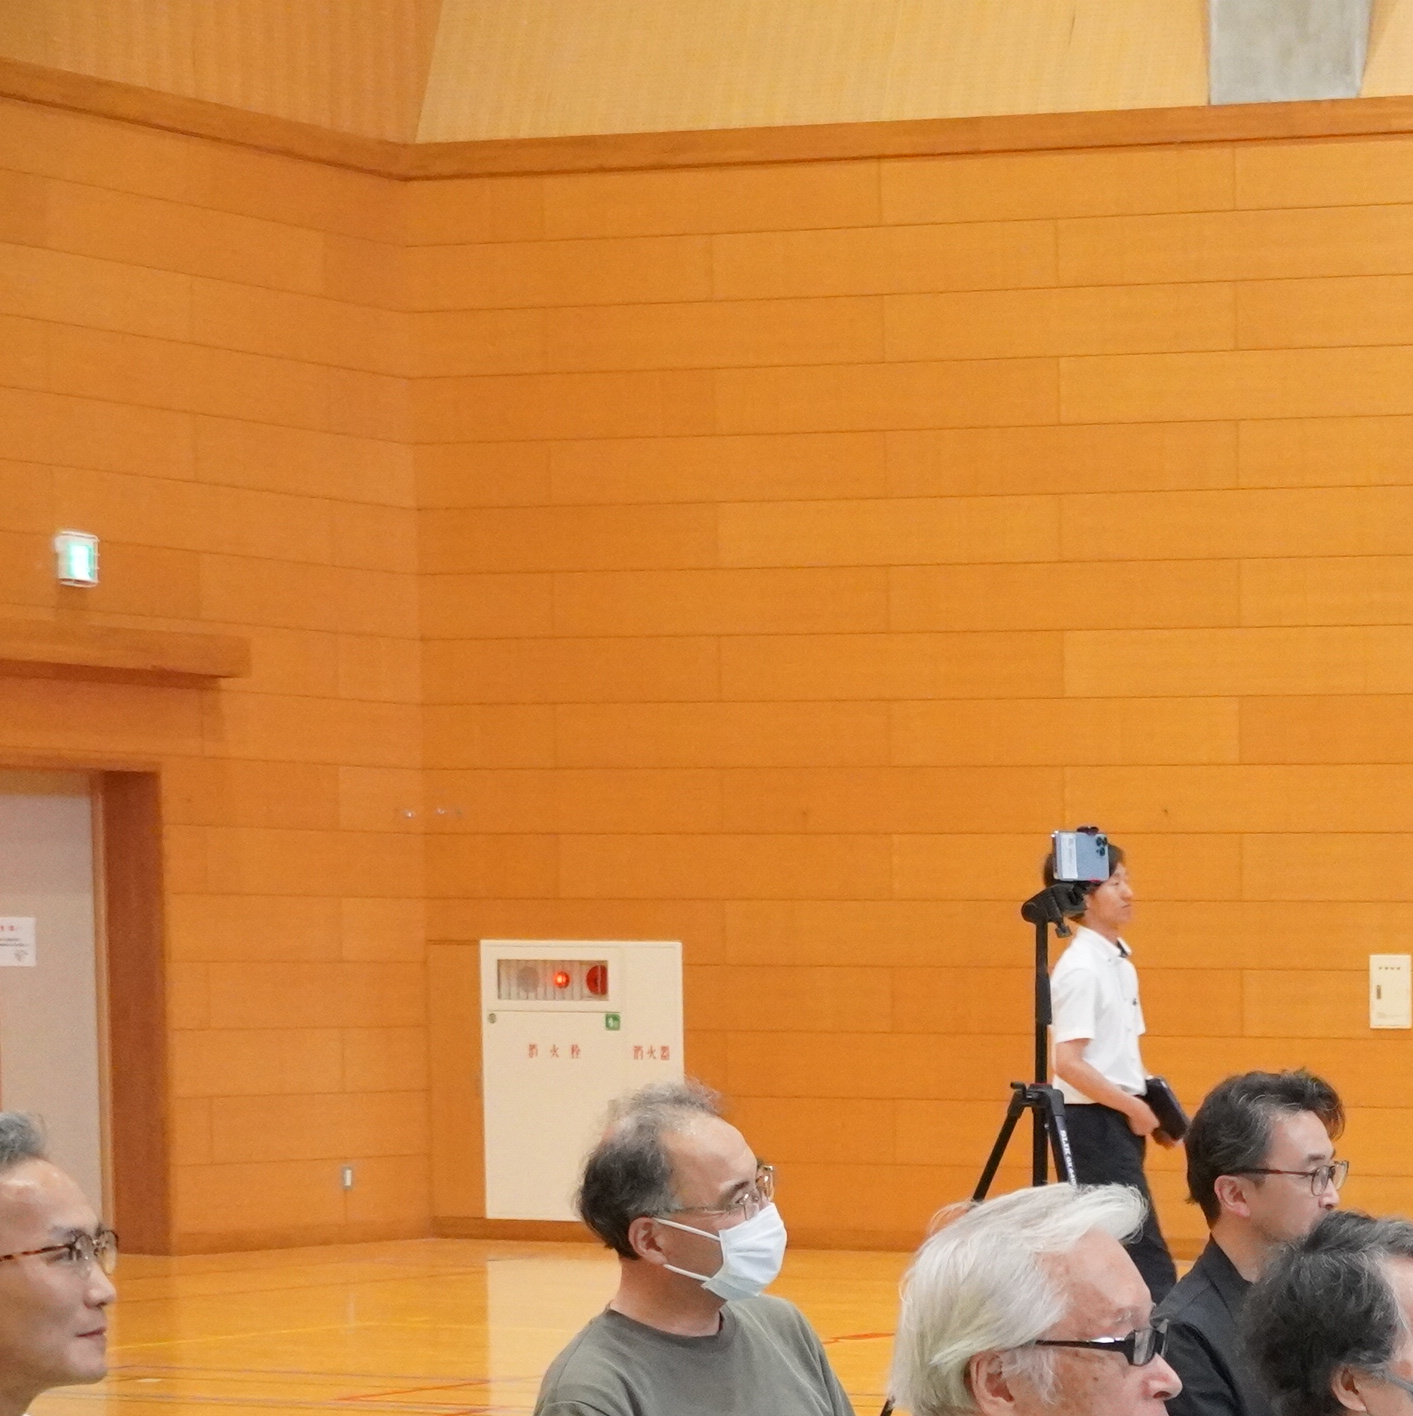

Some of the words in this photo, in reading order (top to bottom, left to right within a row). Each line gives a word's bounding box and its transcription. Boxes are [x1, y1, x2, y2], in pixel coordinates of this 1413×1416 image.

[528, 1043, 581, 1059] 消火栓
[633, 1045, 671, 1060] 消火器
